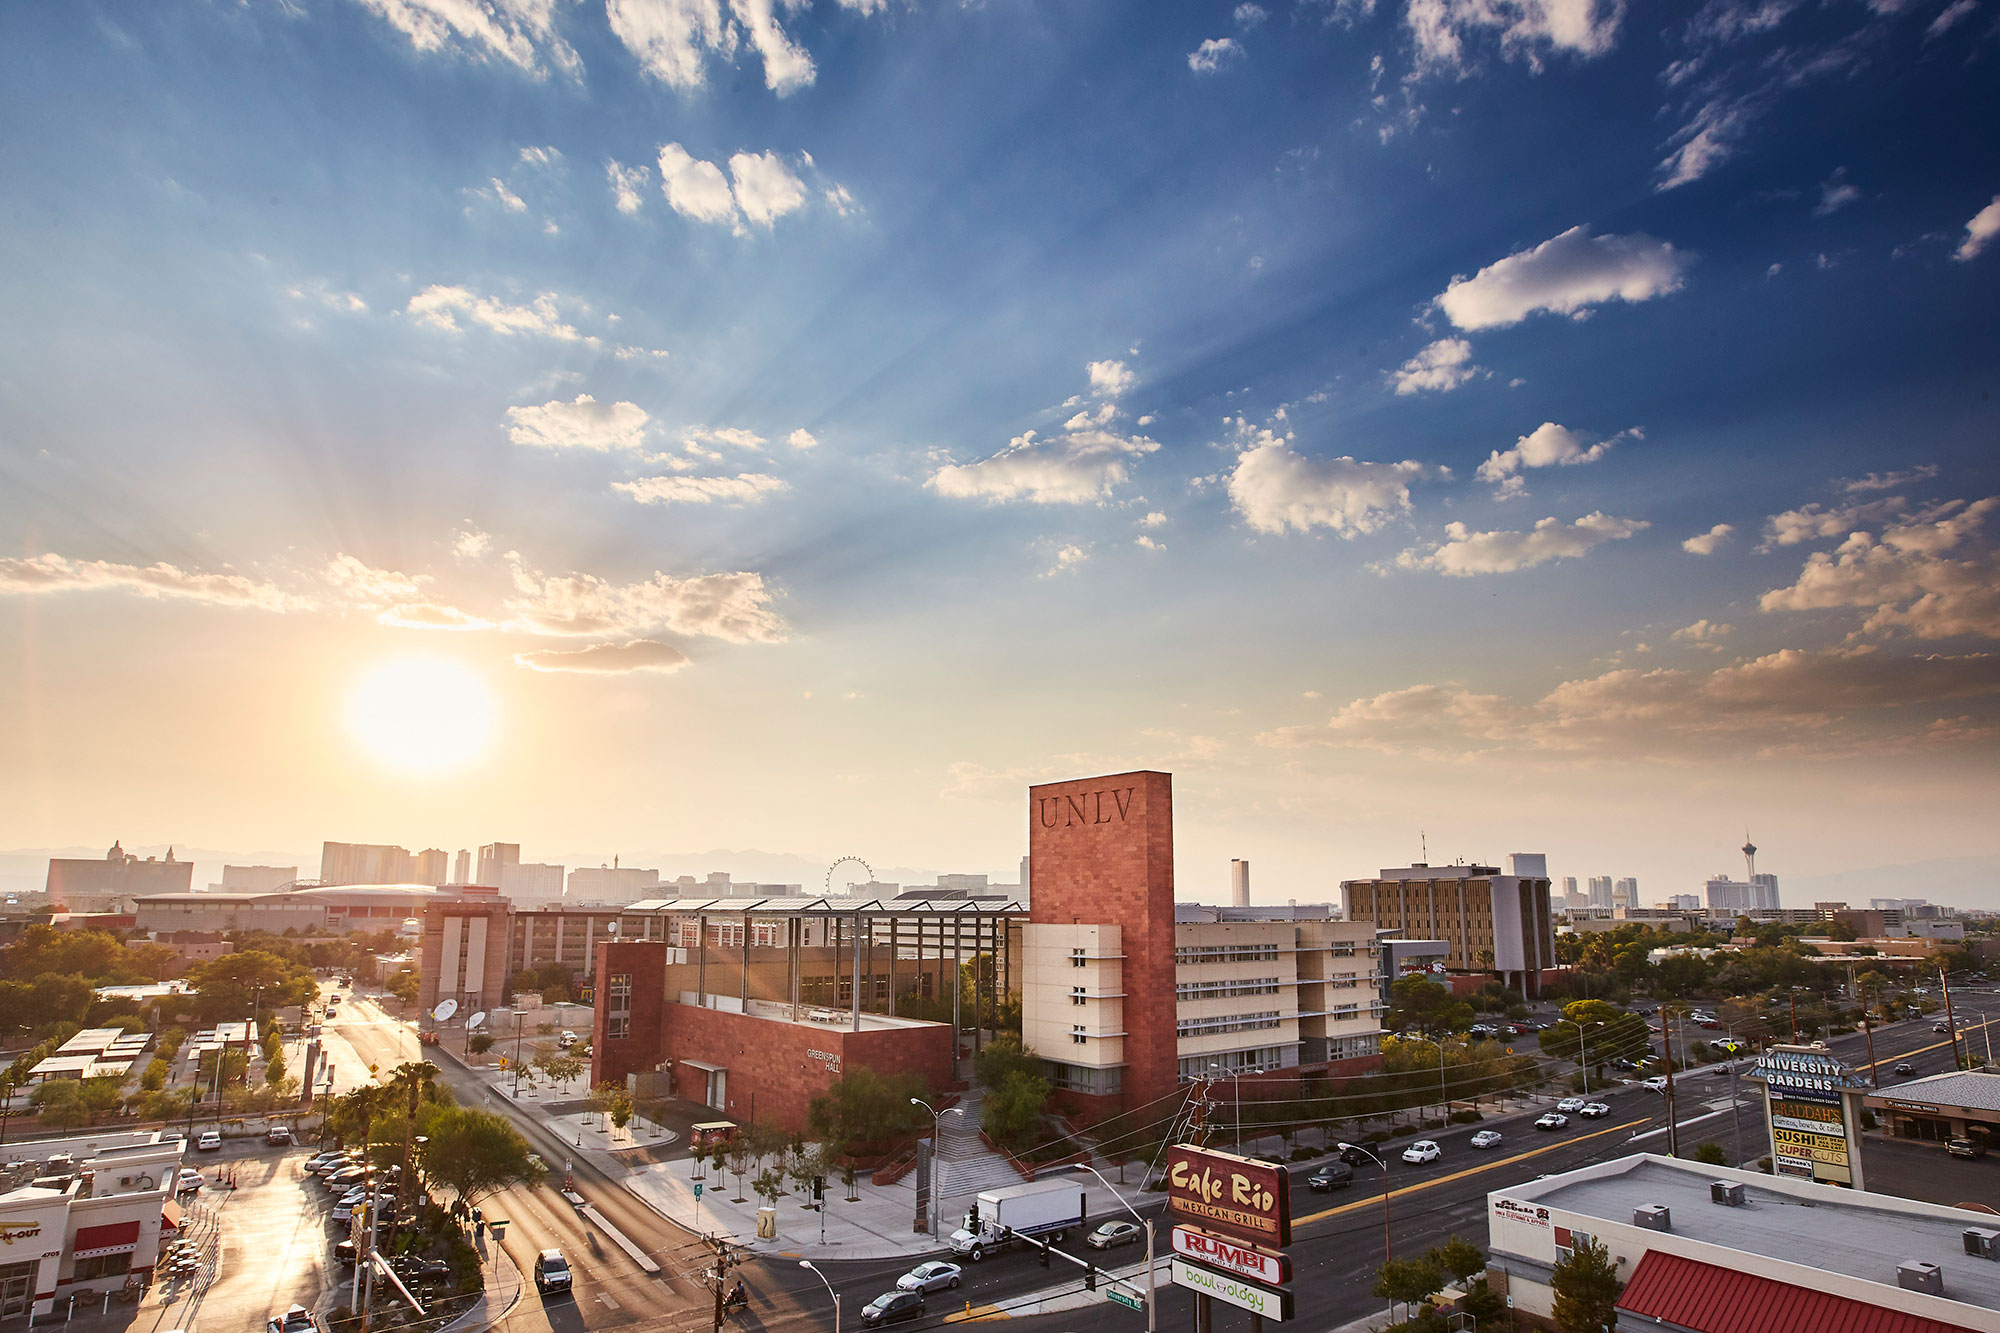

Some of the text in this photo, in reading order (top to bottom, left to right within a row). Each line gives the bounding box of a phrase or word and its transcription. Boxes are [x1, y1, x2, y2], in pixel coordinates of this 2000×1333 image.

[1038, 787, 1135, 829] UNLV
[807, 1048, 841, 1064] GREENSPUN
[825, 1062, 841, 1073] HALL
[1758, 1057, 1841, 1076] UNIVERSITY
[1767, 1074, 1832, 1091] GARDENS
[1773, 1102, 1842, 1123] BRADDAH'S
[1776, 1131, 1816, 1146] SUSHI
[1231, 1173, 1274, 1212] Rio
[1183, 1201, 1264, 1229] MEXICAN GRILL
[1495, 1202, 1534, 1214] Rebels
[41, 1250, 60, 1258] 4705
[1184, 1232, 1267, 1275] RUMBI
[1107, 1290, 1132, 1306] University
